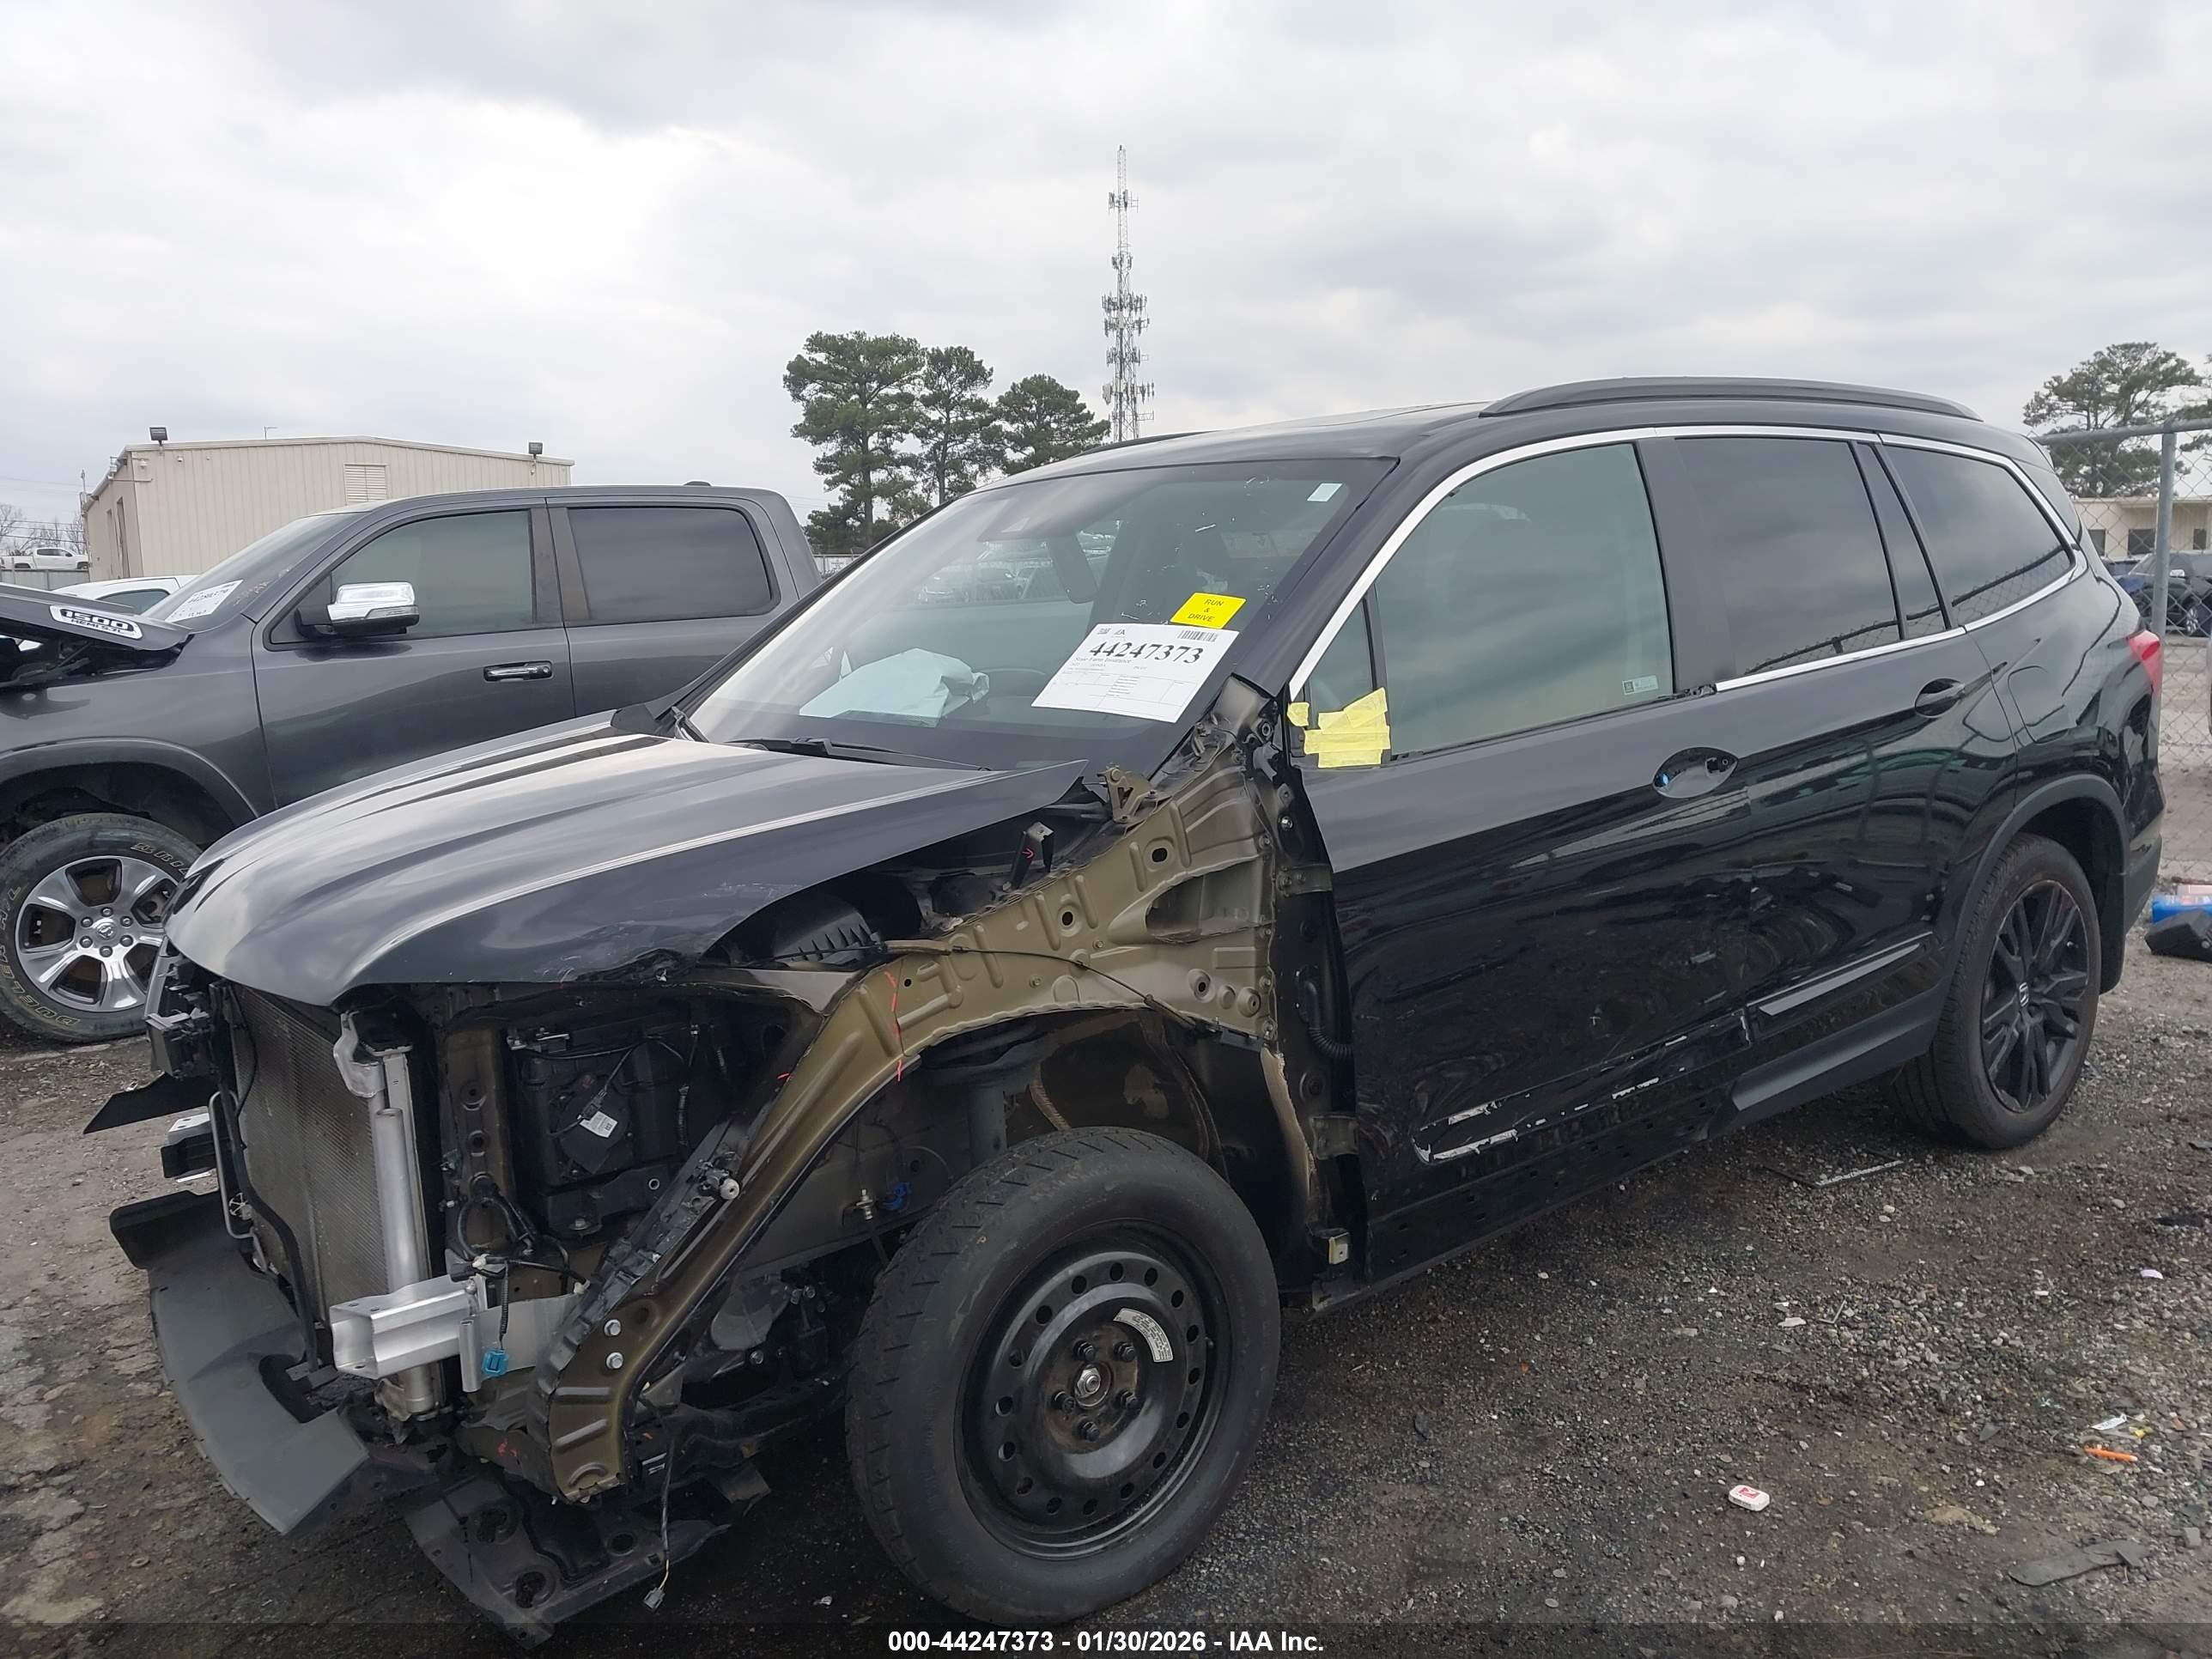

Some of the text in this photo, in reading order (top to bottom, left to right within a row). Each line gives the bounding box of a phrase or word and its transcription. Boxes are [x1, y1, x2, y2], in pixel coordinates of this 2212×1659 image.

[66, 611, 129, 630] 1500
[70, 618, 99, 629] HEMI
[1188, 613, 1215, 623] DRIVE
[1089, 641, 1204, 664] 44247373
